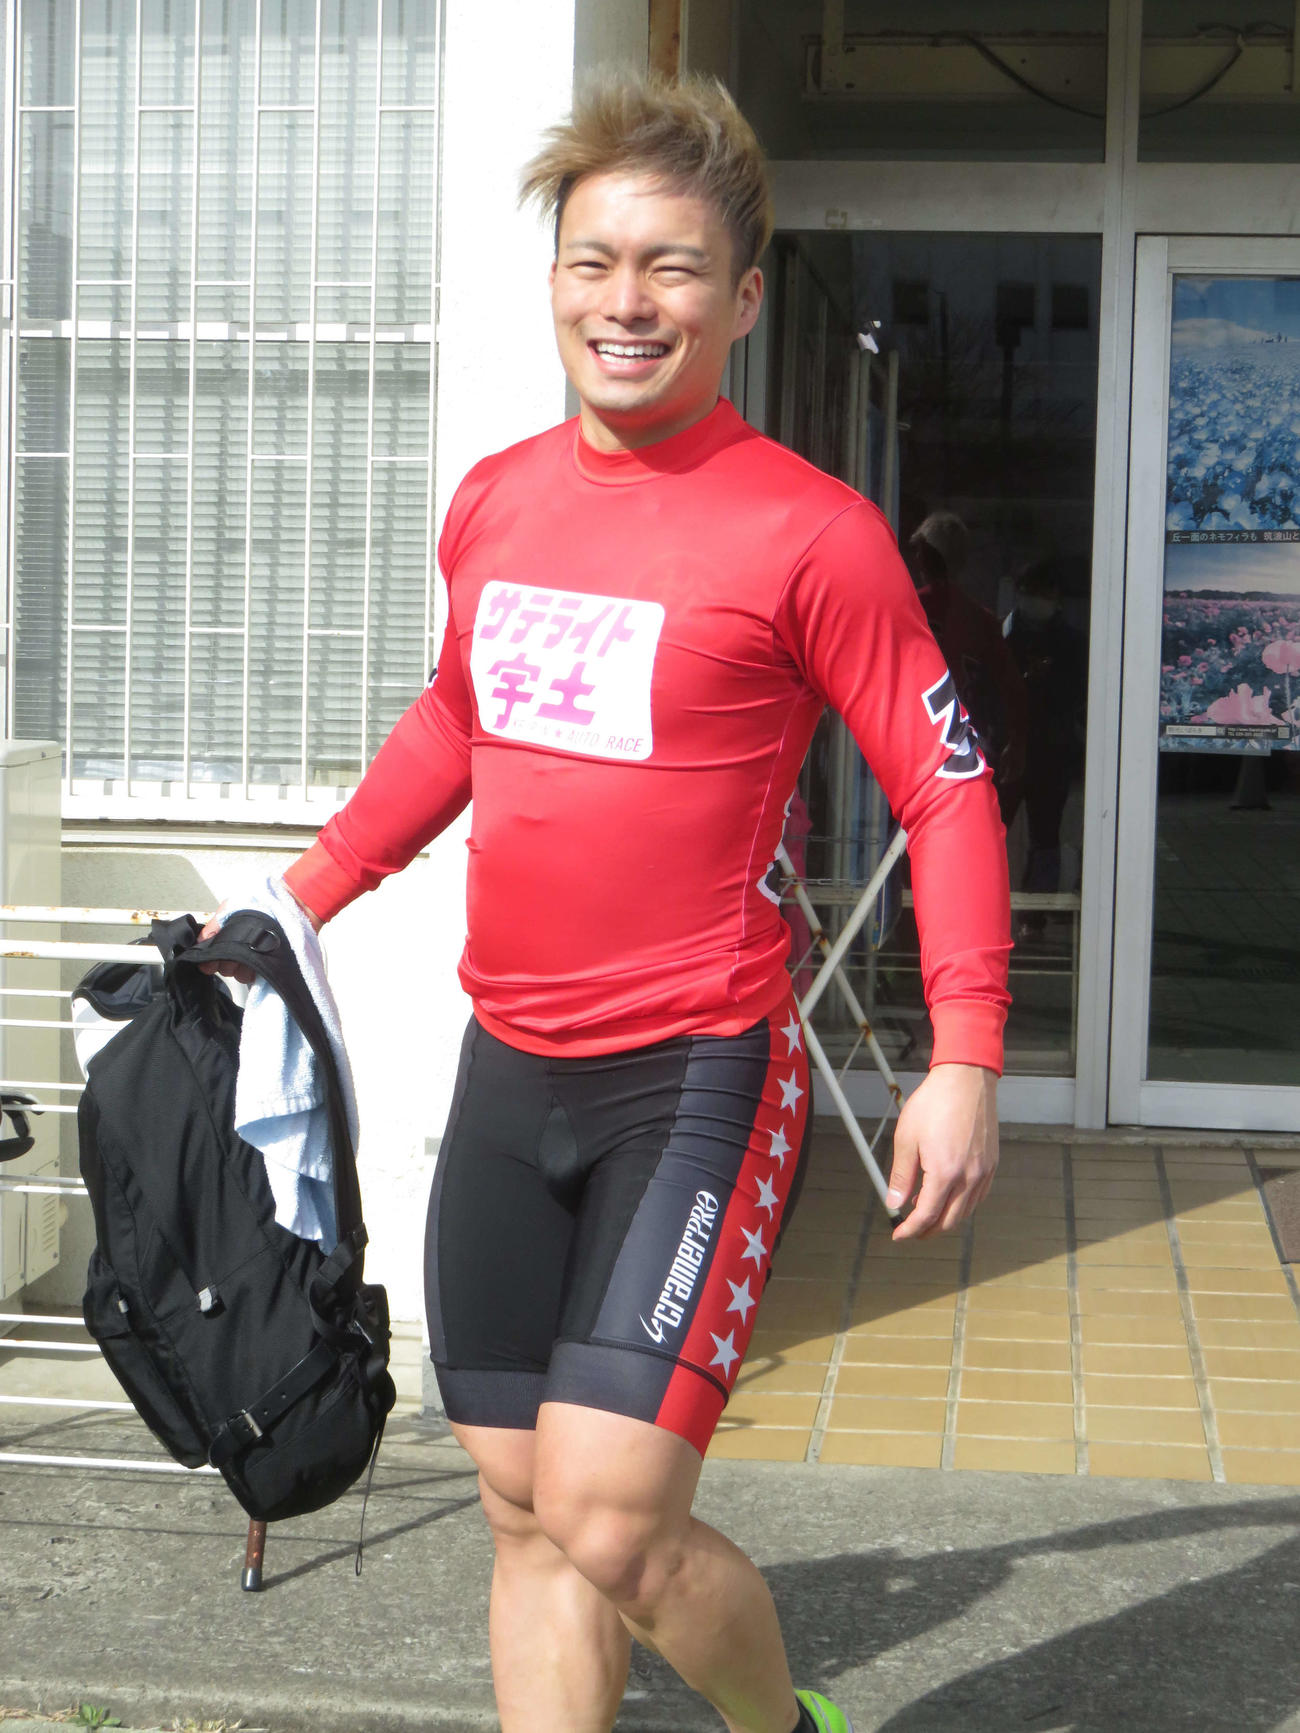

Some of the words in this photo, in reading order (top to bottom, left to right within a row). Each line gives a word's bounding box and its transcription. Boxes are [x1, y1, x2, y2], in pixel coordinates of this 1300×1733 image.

[480, 589, 635, 658] サテライト
[487, 653, 597, 730] 宇土
[567, 729, 600, 747] AUTO
[606, 736, 645, 753] RACE
